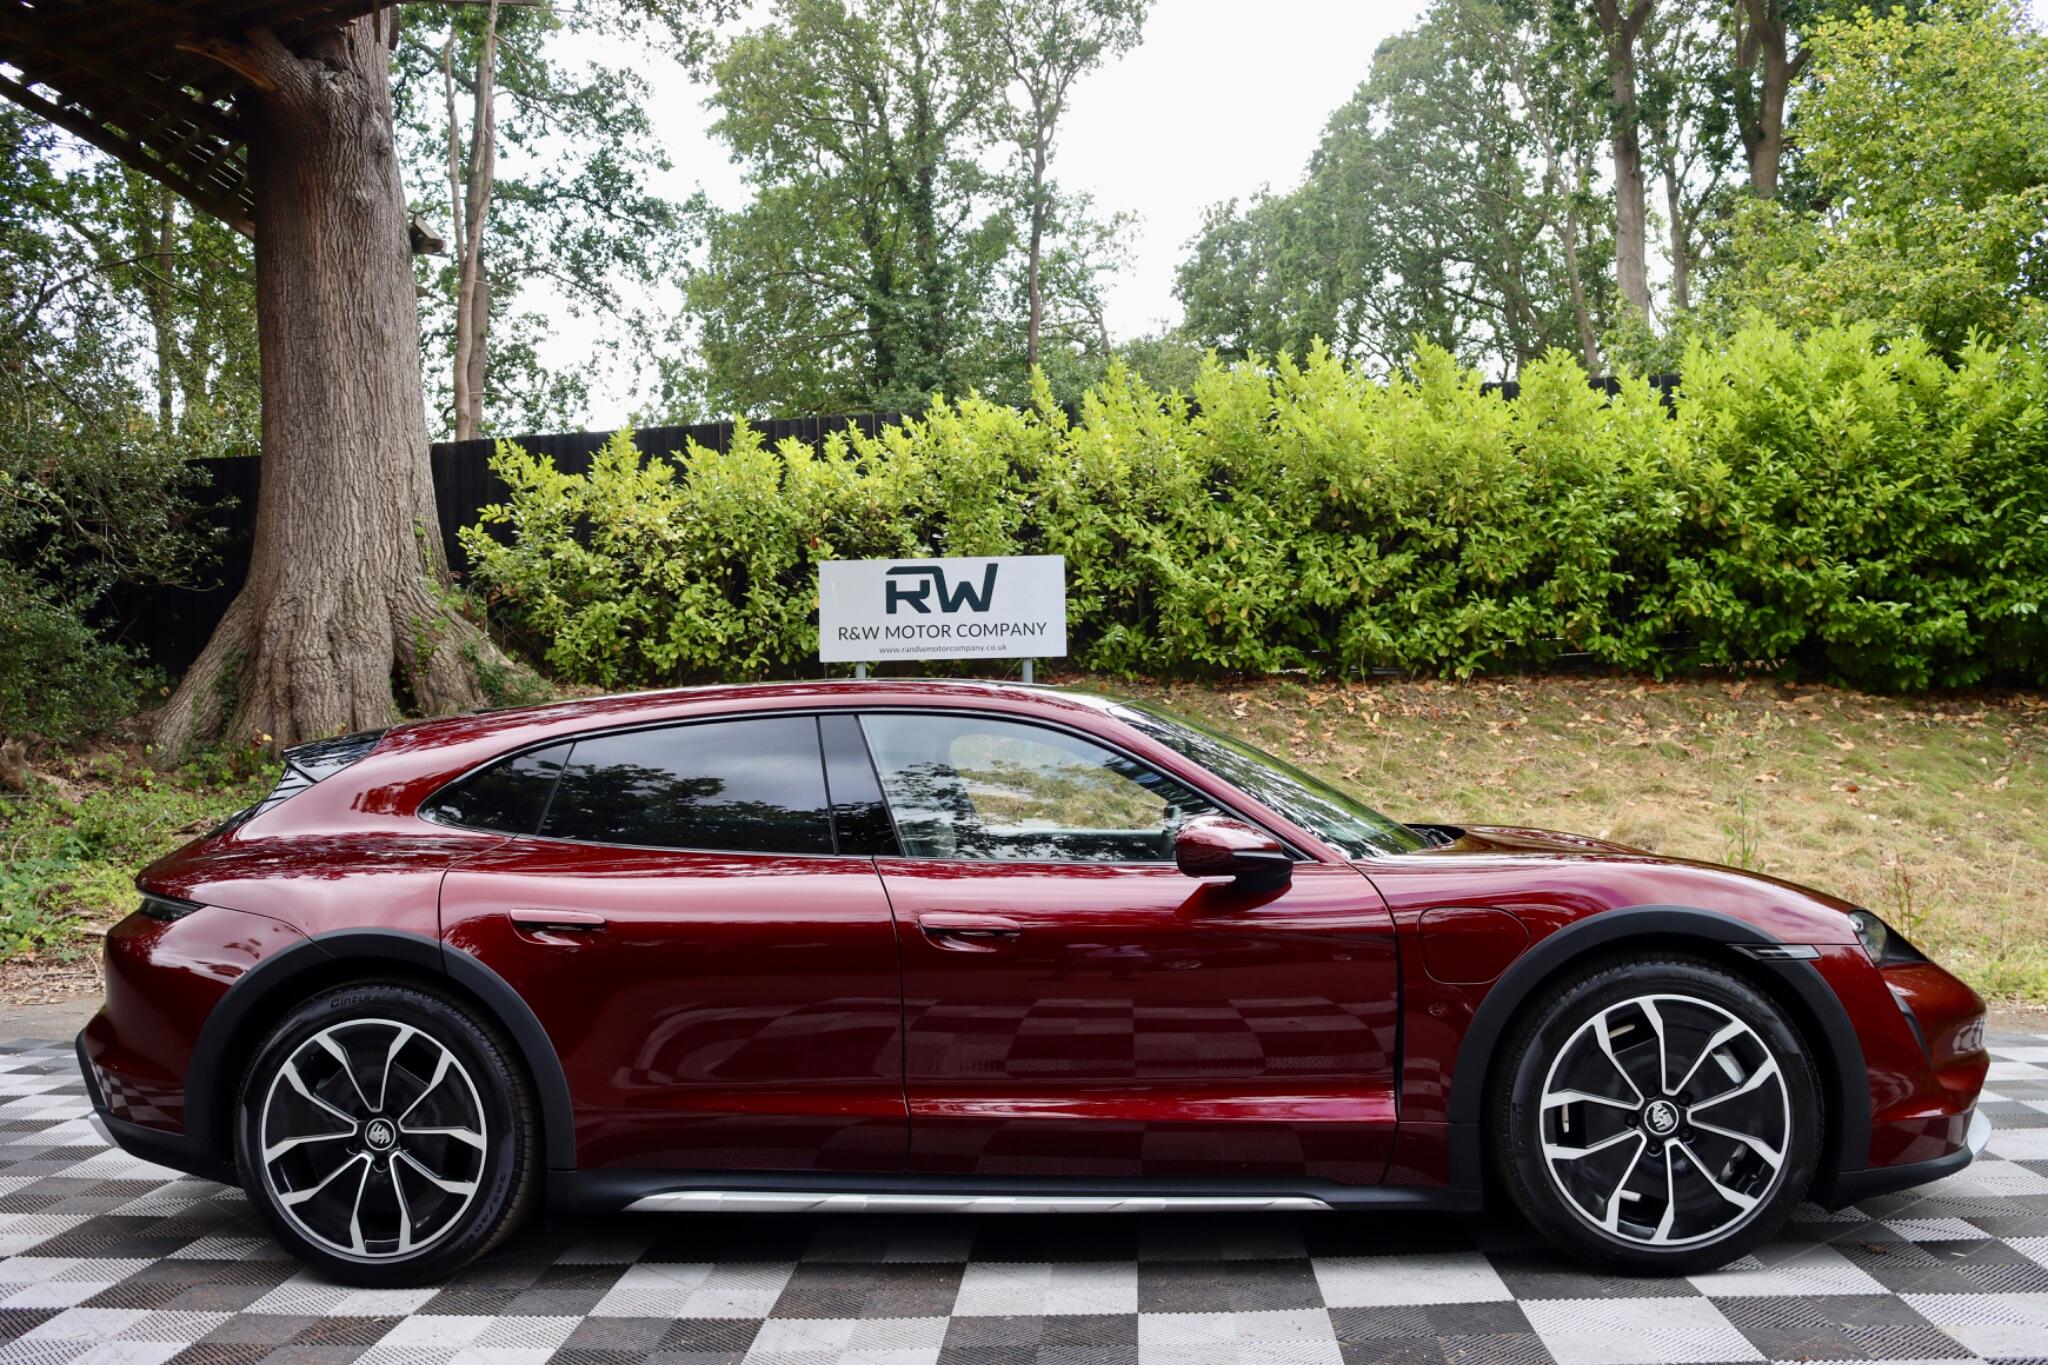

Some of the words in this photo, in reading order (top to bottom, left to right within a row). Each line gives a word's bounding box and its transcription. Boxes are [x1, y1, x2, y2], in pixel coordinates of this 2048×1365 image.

[886, 563, 998, 614] RW
[838, 626, 880, 641] R&W
[885, 624, 951, 639] MOTOR
[957, 622, 1047, 638] COMPANY
[878, 643, 1007, 654] www.randwmotorcompany.co.uk
